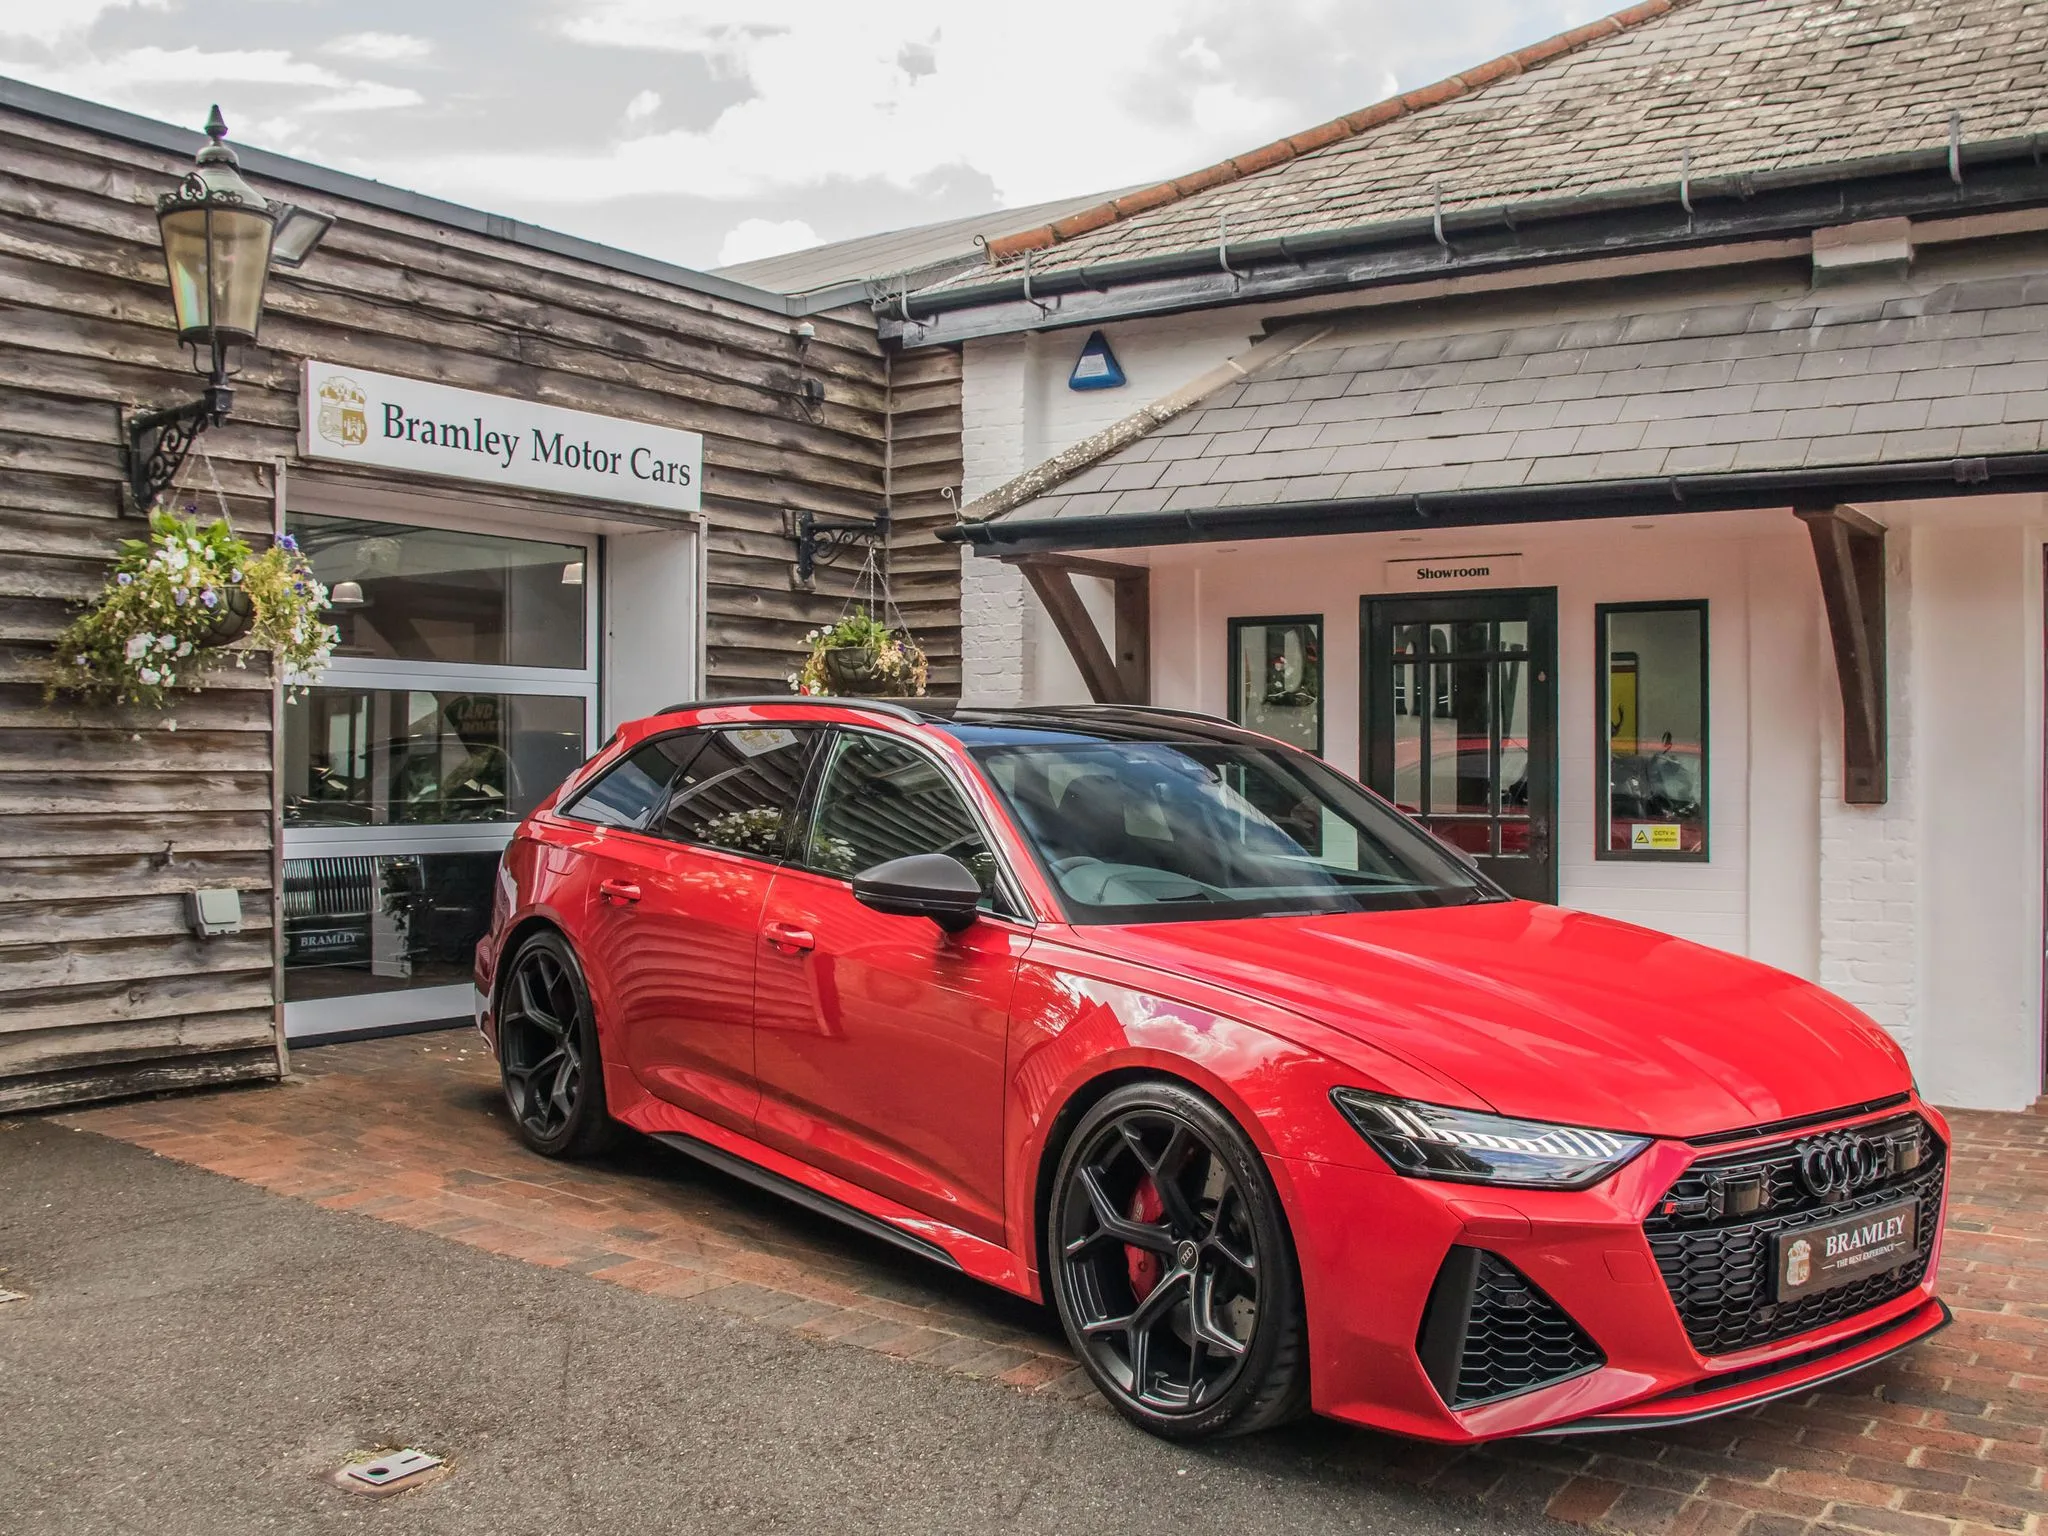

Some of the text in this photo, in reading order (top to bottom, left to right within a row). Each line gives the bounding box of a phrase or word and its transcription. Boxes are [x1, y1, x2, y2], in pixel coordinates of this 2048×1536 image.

[381, 402, 691, 487] Bramley Motor Cars
[1417, 566, 1490, 580] Showroom
[300, 932, 356, 947] BRAMLEY
[1825, 1214, 1905, 1257] BRAMLEY
[1836, 1258, 1849, 1268] THE
[1849, 1254, 1862, 1265] BEST
